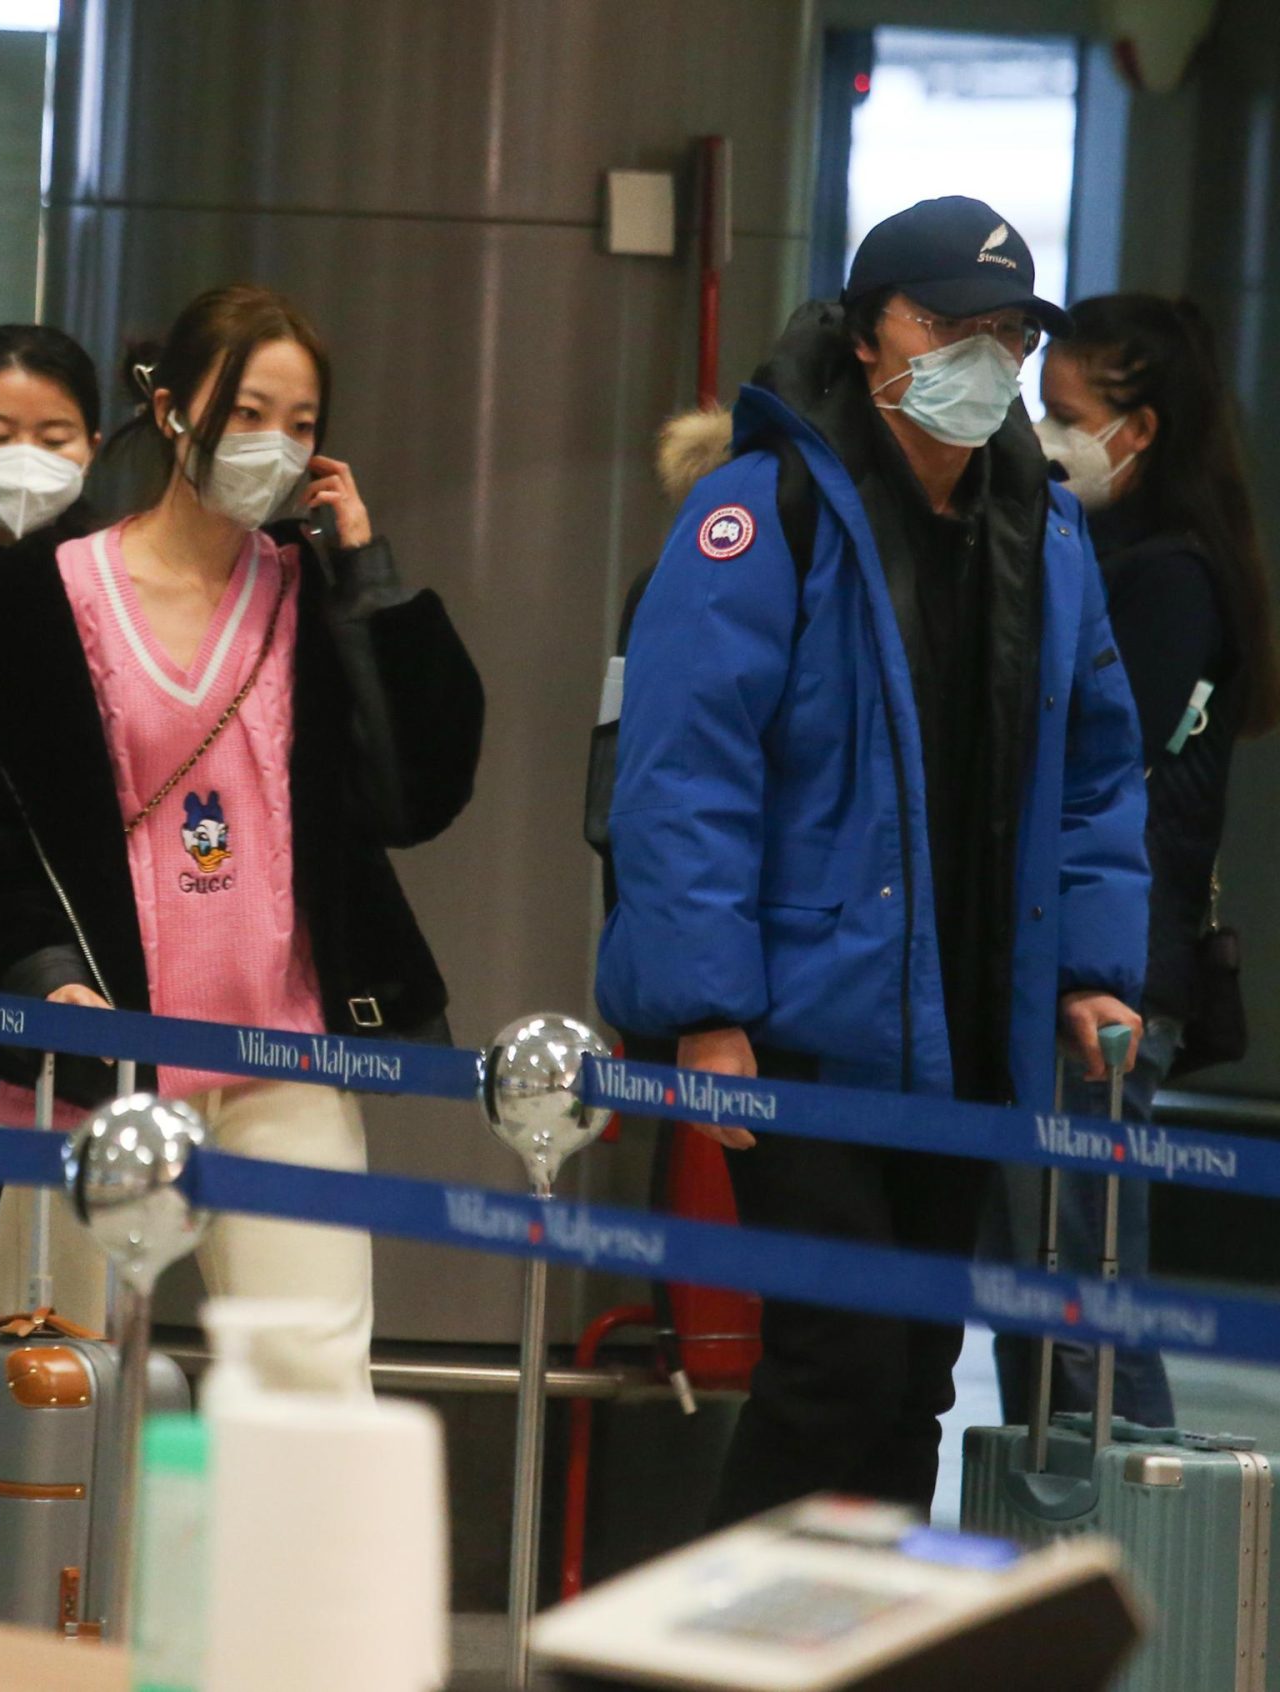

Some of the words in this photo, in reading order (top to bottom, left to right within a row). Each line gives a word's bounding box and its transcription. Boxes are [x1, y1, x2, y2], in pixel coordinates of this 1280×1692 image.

[237, 1030, 299, 1070] Milano
[312, 1038, 401, 1084] Malpensa
[595, 1061, 663, 1105] Milano
[677, 1072, 777, 1122] Malpensa
[1035, 1114, 1112, 1161] Milano
[1125, 1125, 1237, 1179] Malpensa
